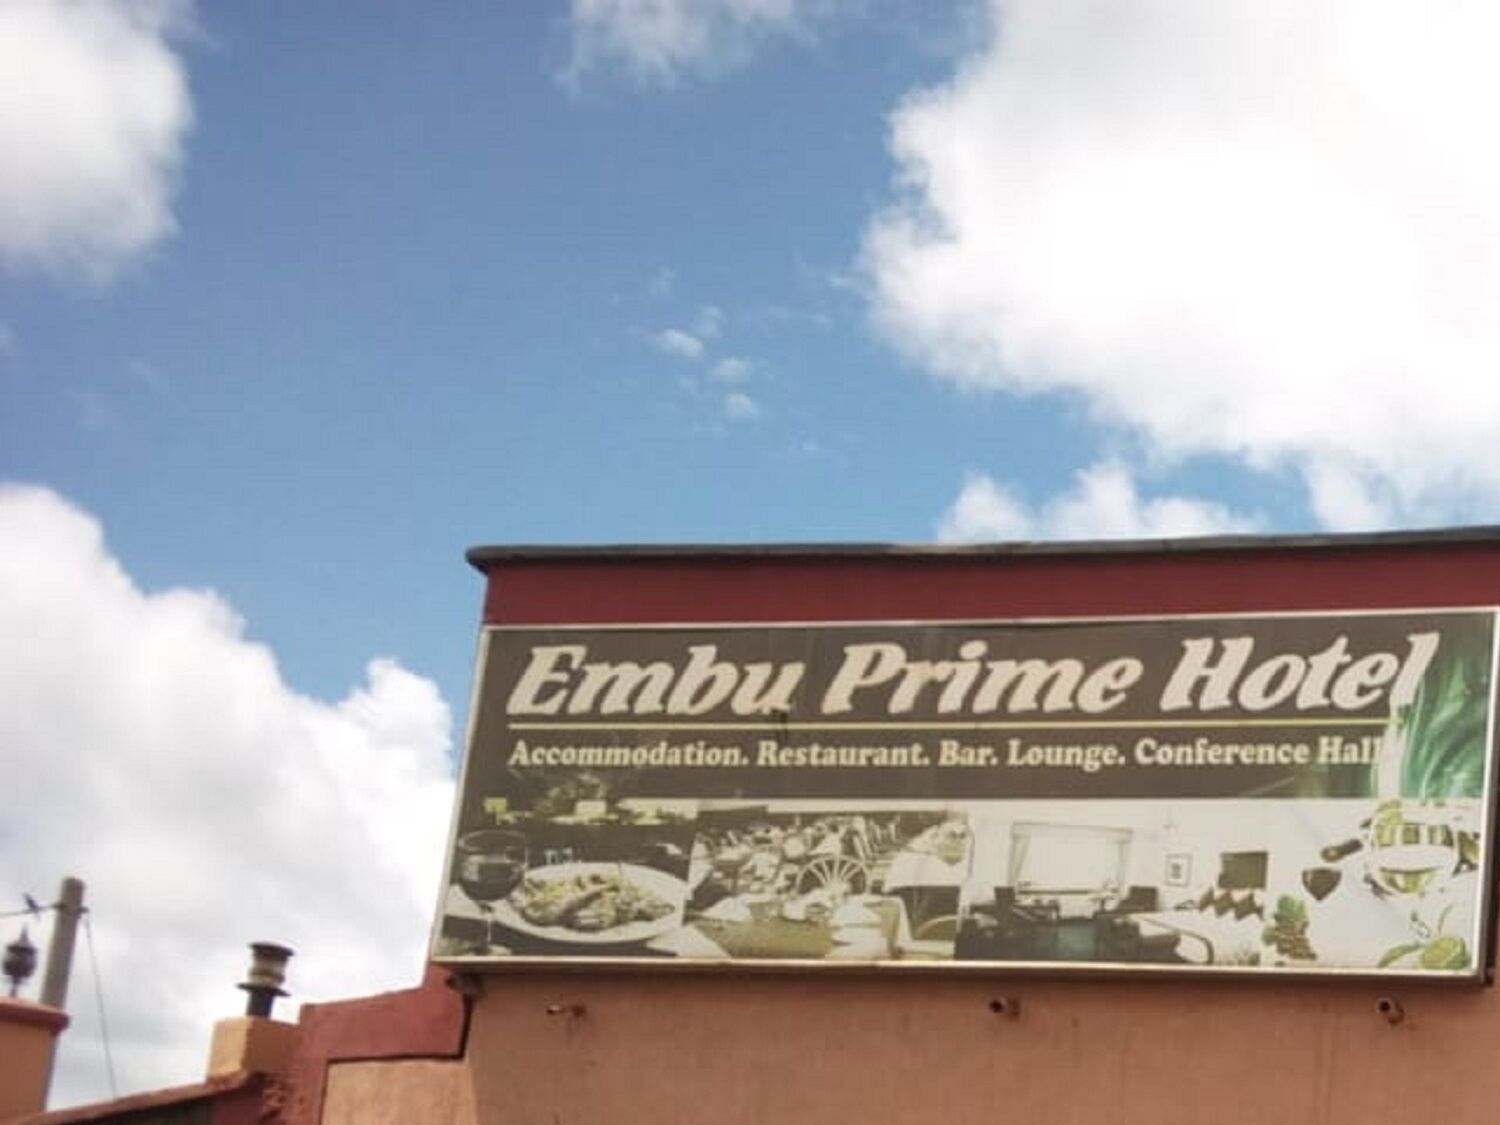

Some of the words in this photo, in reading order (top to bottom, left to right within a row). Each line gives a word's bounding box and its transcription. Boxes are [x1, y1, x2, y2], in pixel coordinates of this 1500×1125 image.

[506, 644, 806, 716] Embu
[822, 639, 1144, 715] Prime
[1160, 632, 1440, 712] Hotel
[507, 739, 750, 767] Accommodation.
[756, 740, 931, 767] Restaurant.
[938, 739, 998, 767] Bar.
[1007, 737, 1126, 773] Lounge.
[1135, 736, 1309, 766] Conference
